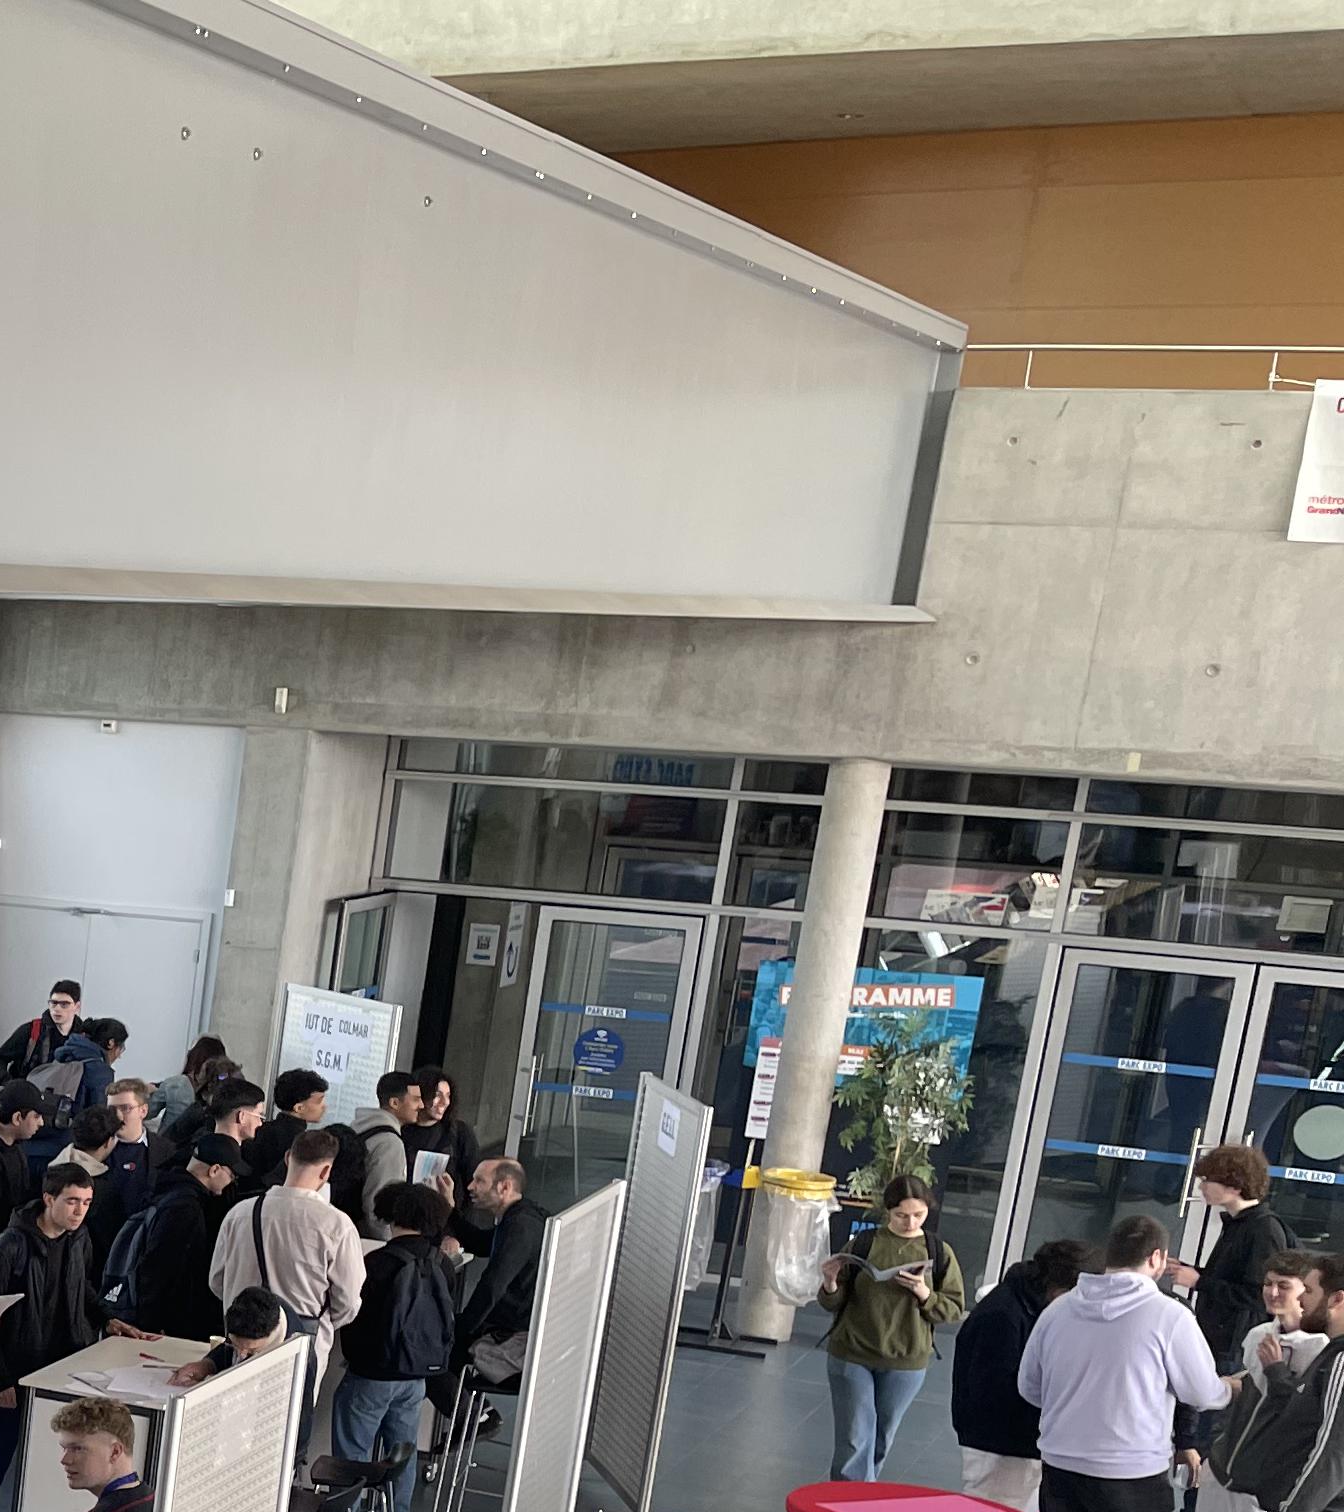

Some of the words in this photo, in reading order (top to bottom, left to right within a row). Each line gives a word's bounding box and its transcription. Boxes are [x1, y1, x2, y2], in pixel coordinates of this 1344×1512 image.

[781, 986, 952, 1006] PRAMME
[587, 1006, 604, 1016] PARC
[606, 1008, 625, 1018] EXPO
[305, 1013, 320, 1030] IUT
[321, 1017, 334, 1035] DE
[339, 1020, 369, 1038] COLMAR
[1120, 1059, 1141, 1070] PARC
[1142, 1061, 1164, 1072] EXPO
[1312, 1080, 1333, 1090] PARC
[574, 1086, 591, 1096] PARC
[592, 1088, 612, 1098] EXPO
[1100, 1146, 1120, 1157] PARC
[1121, 1148, 1144, 1159] EXPO
[1288, 1169, 1309, 1180] PARC
[1311, 1171, 1332, 1183] EXPO
